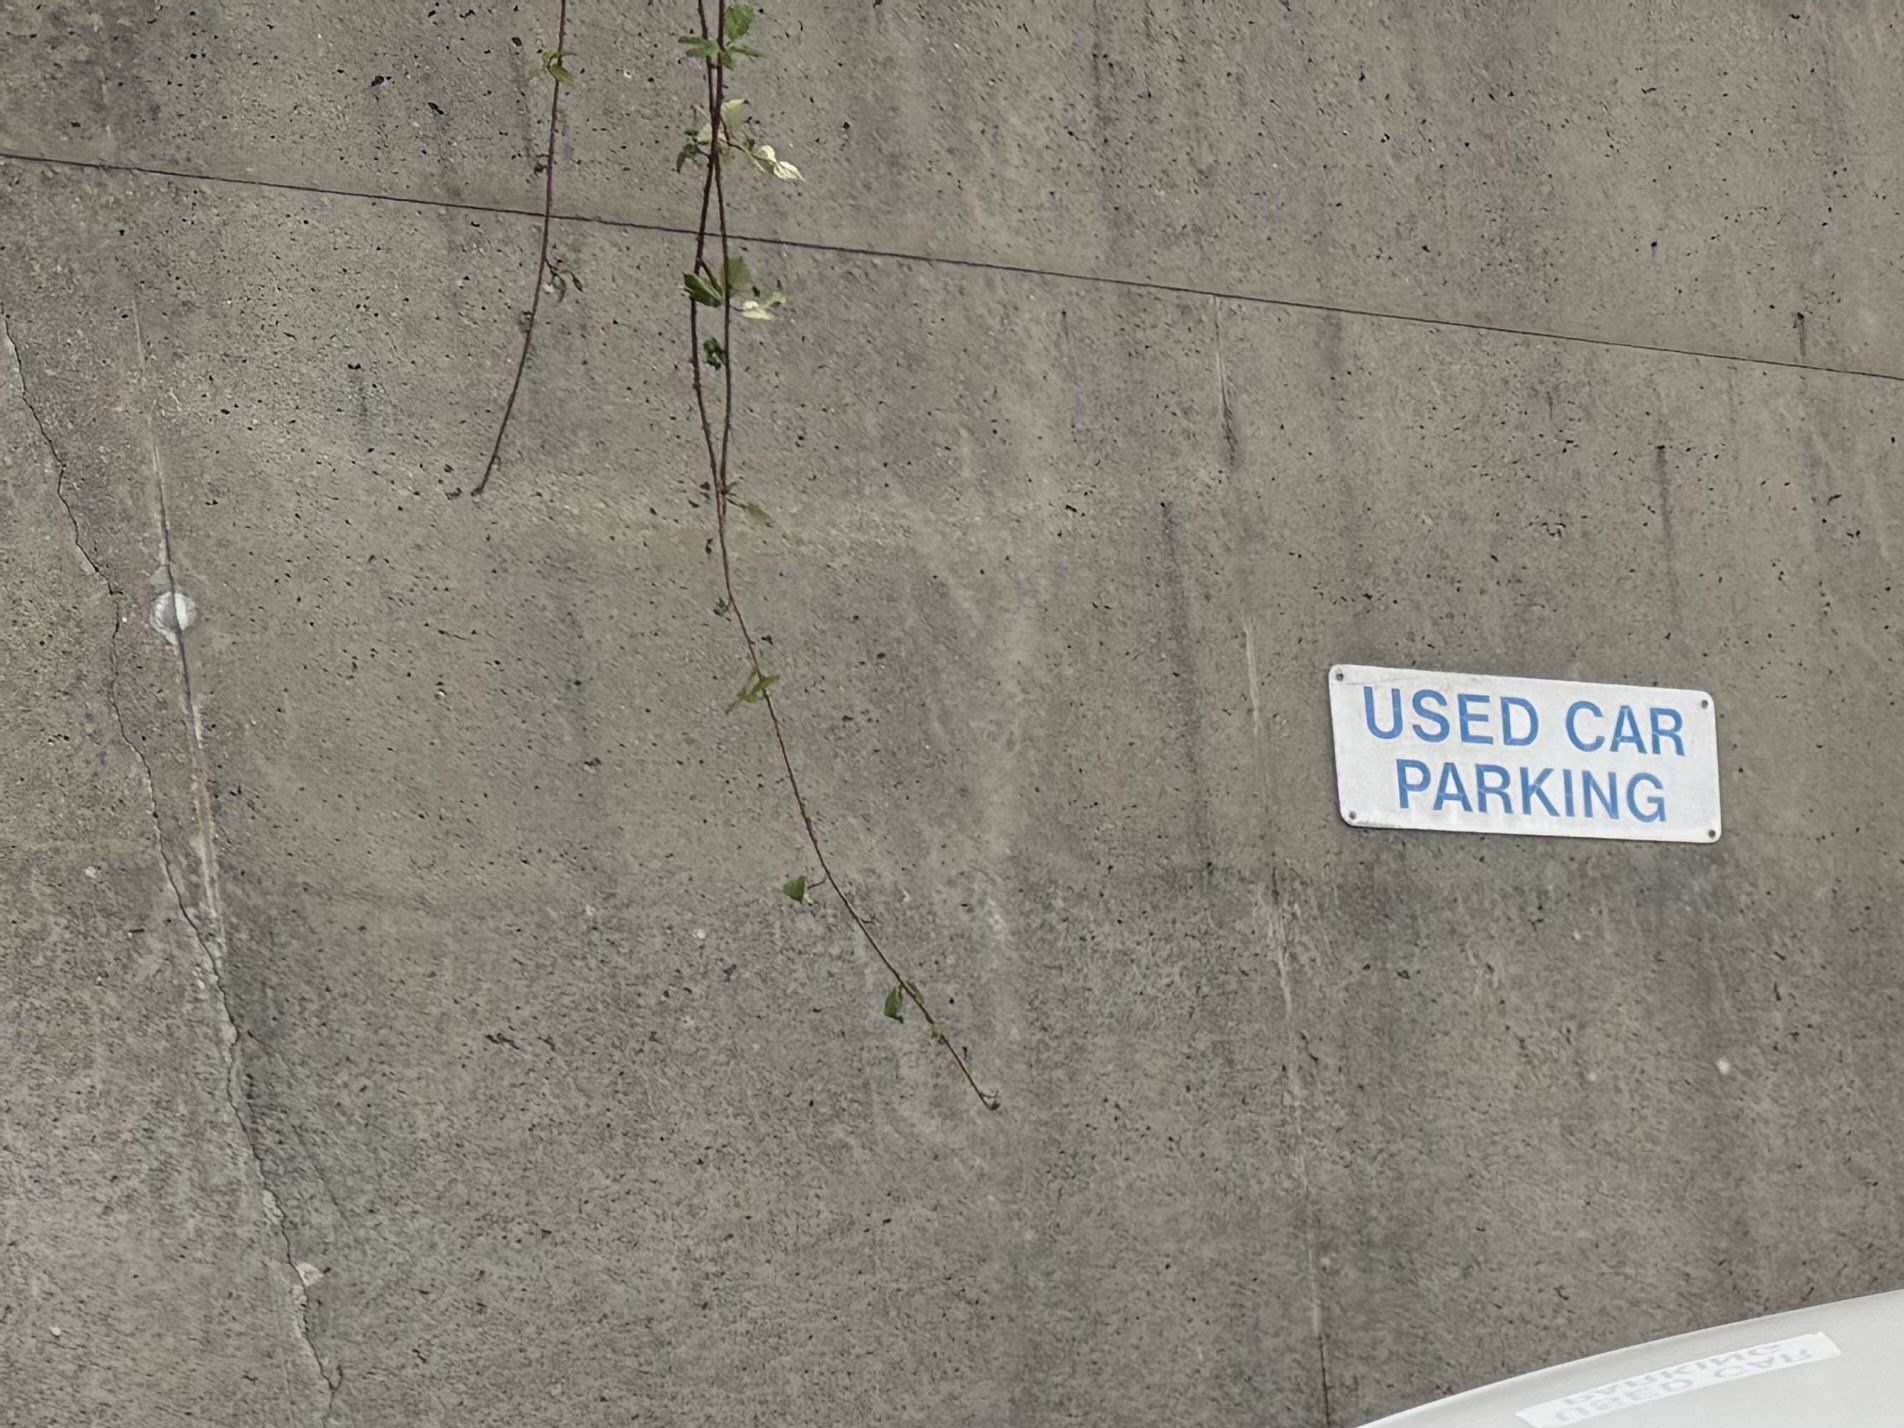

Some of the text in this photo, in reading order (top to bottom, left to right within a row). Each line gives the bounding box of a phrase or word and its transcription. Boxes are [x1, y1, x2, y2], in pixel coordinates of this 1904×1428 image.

[1363, 686, 1686, 757] USED CAR
[1396, 758, 1667, 824] PARKING
